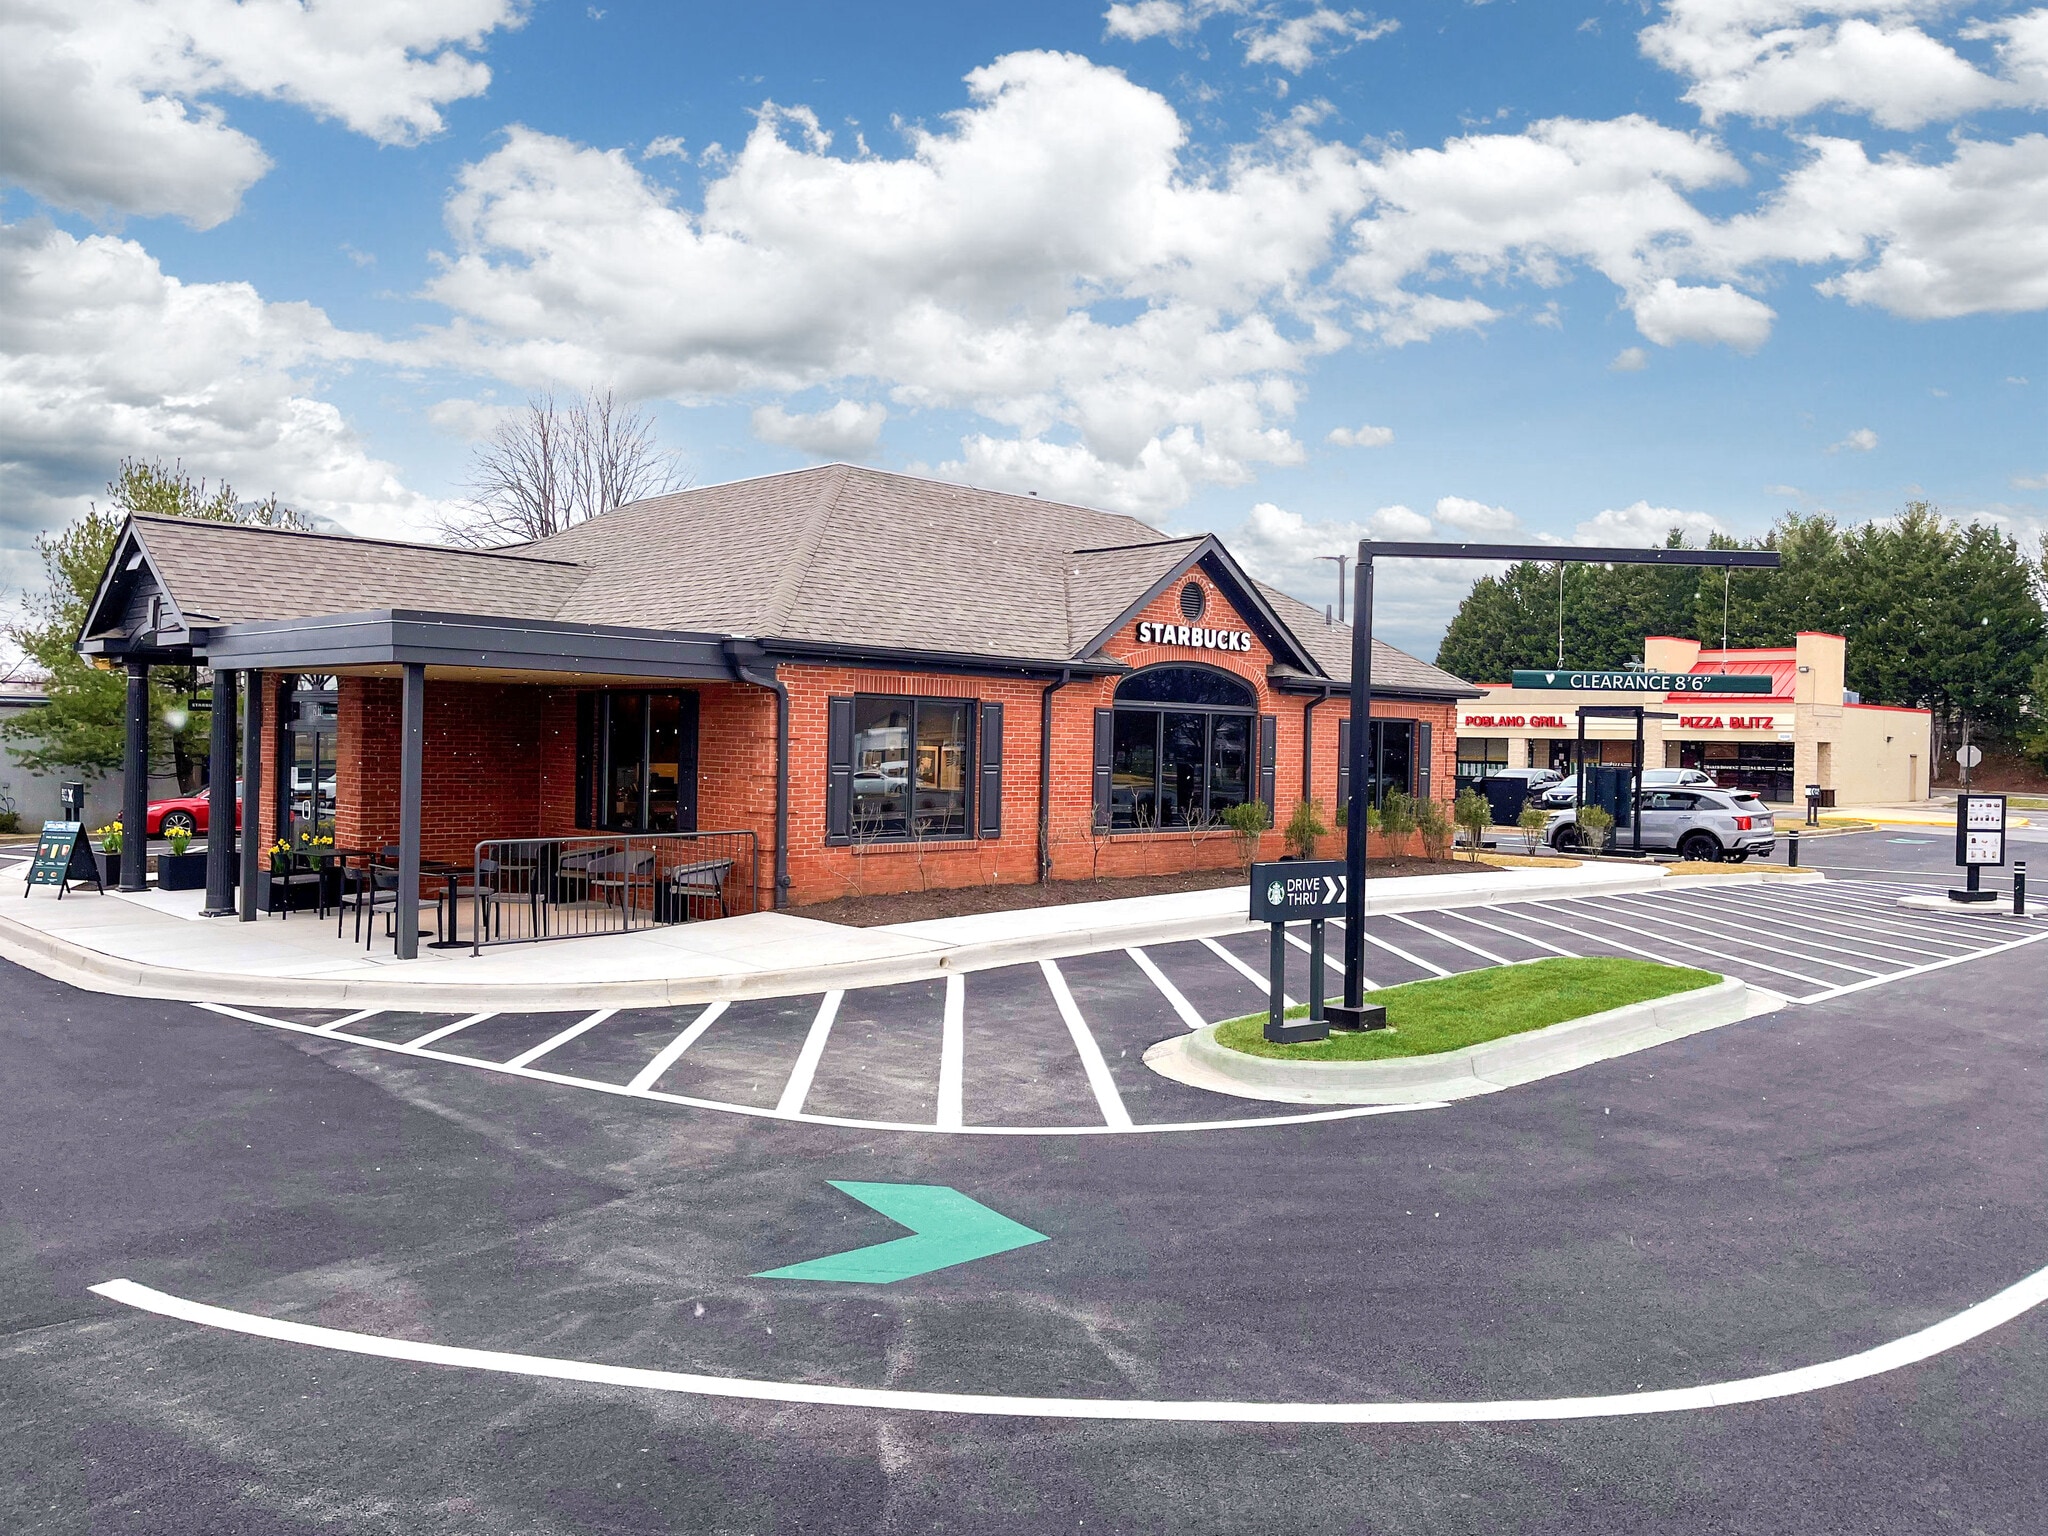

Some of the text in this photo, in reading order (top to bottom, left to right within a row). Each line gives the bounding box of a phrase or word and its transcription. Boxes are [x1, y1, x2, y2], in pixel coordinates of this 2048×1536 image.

[1139, 622, 1251, 652] STARBUCKS
[1570, 674, 1670, 690] CLEARANCE
[1465, 715, 1567, 728] POBLANO GRILL
[1680, 716, 1774, 729] PIZZA BLITZ
[1287, 877, 1320, 892] DRIVE
[1287, 892, 1318, 906] THRU
